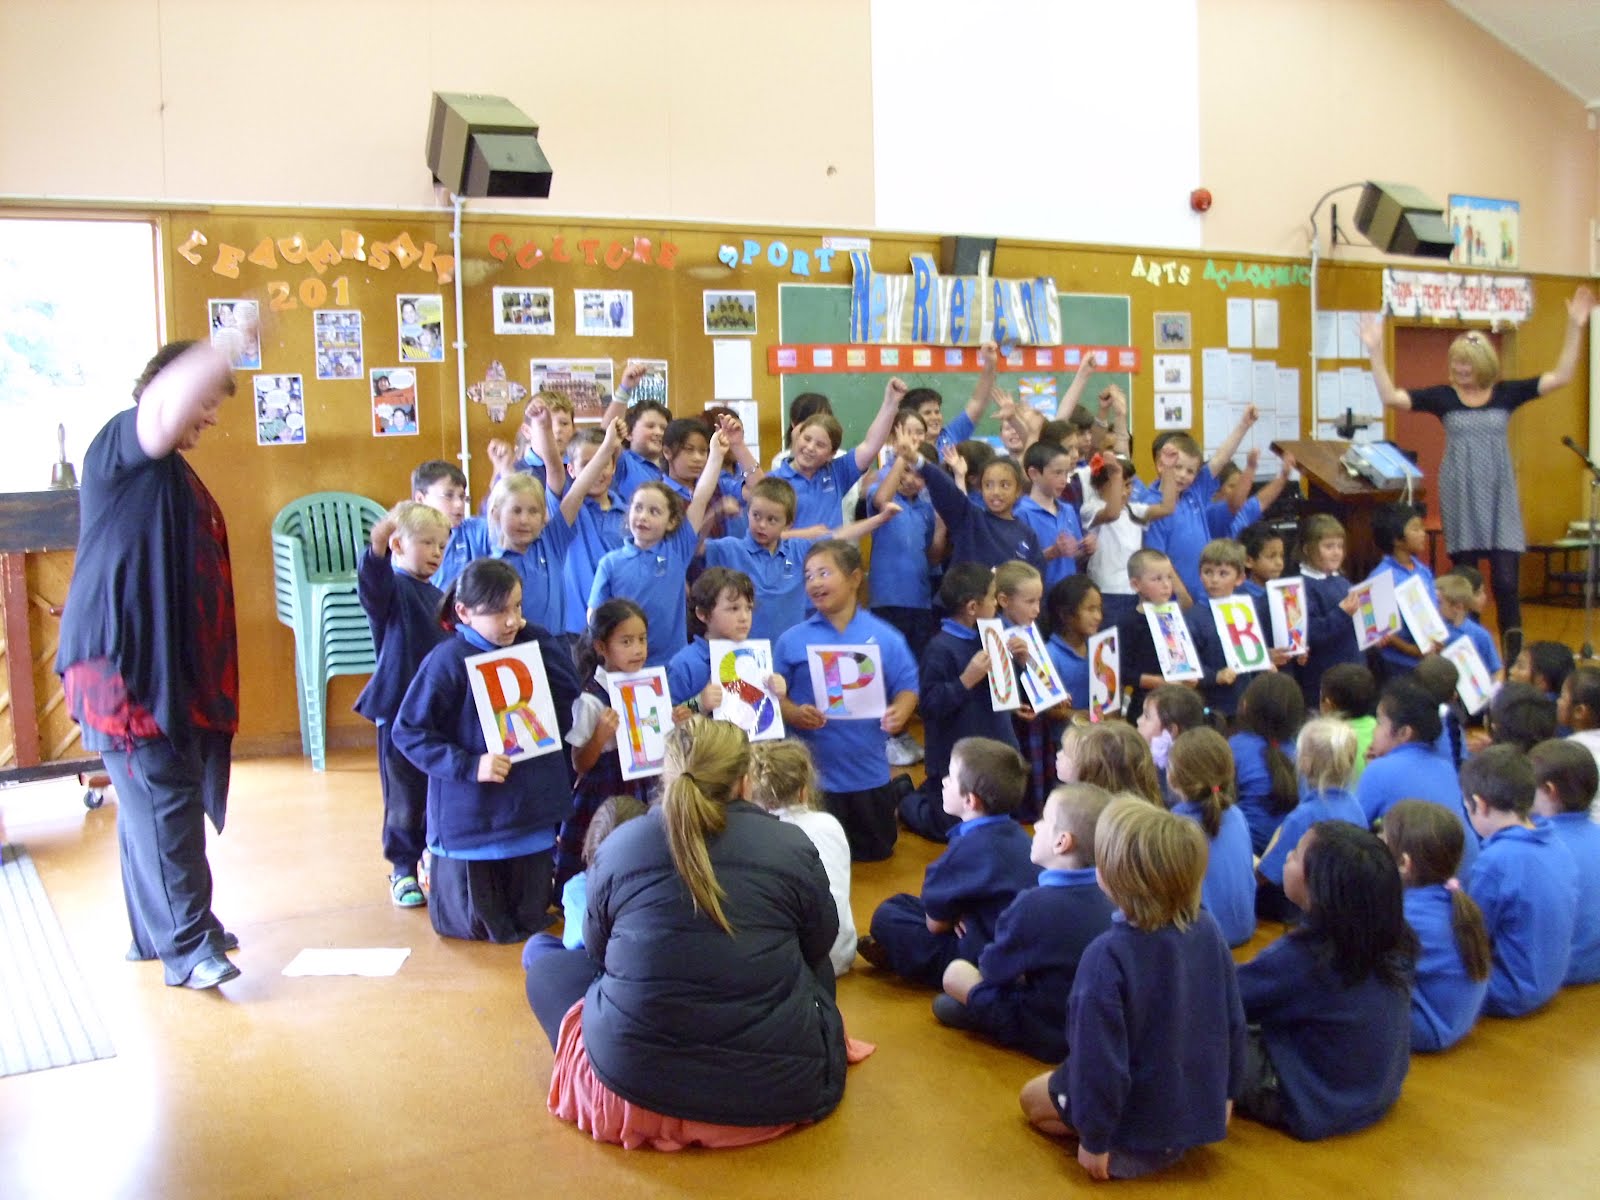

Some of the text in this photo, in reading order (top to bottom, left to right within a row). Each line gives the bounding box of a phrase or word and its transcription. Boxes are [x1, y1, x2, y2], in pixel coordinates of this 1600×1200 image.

[488, 233, 680, 270] CULTURE
[718, 239, 836, 276] SPORT
[1131, 255, 1191, 286] ARTS
[267, 276, 350, 312] 201
[852, 251, 908, 344] New
[911, 255, 976, 344] River
